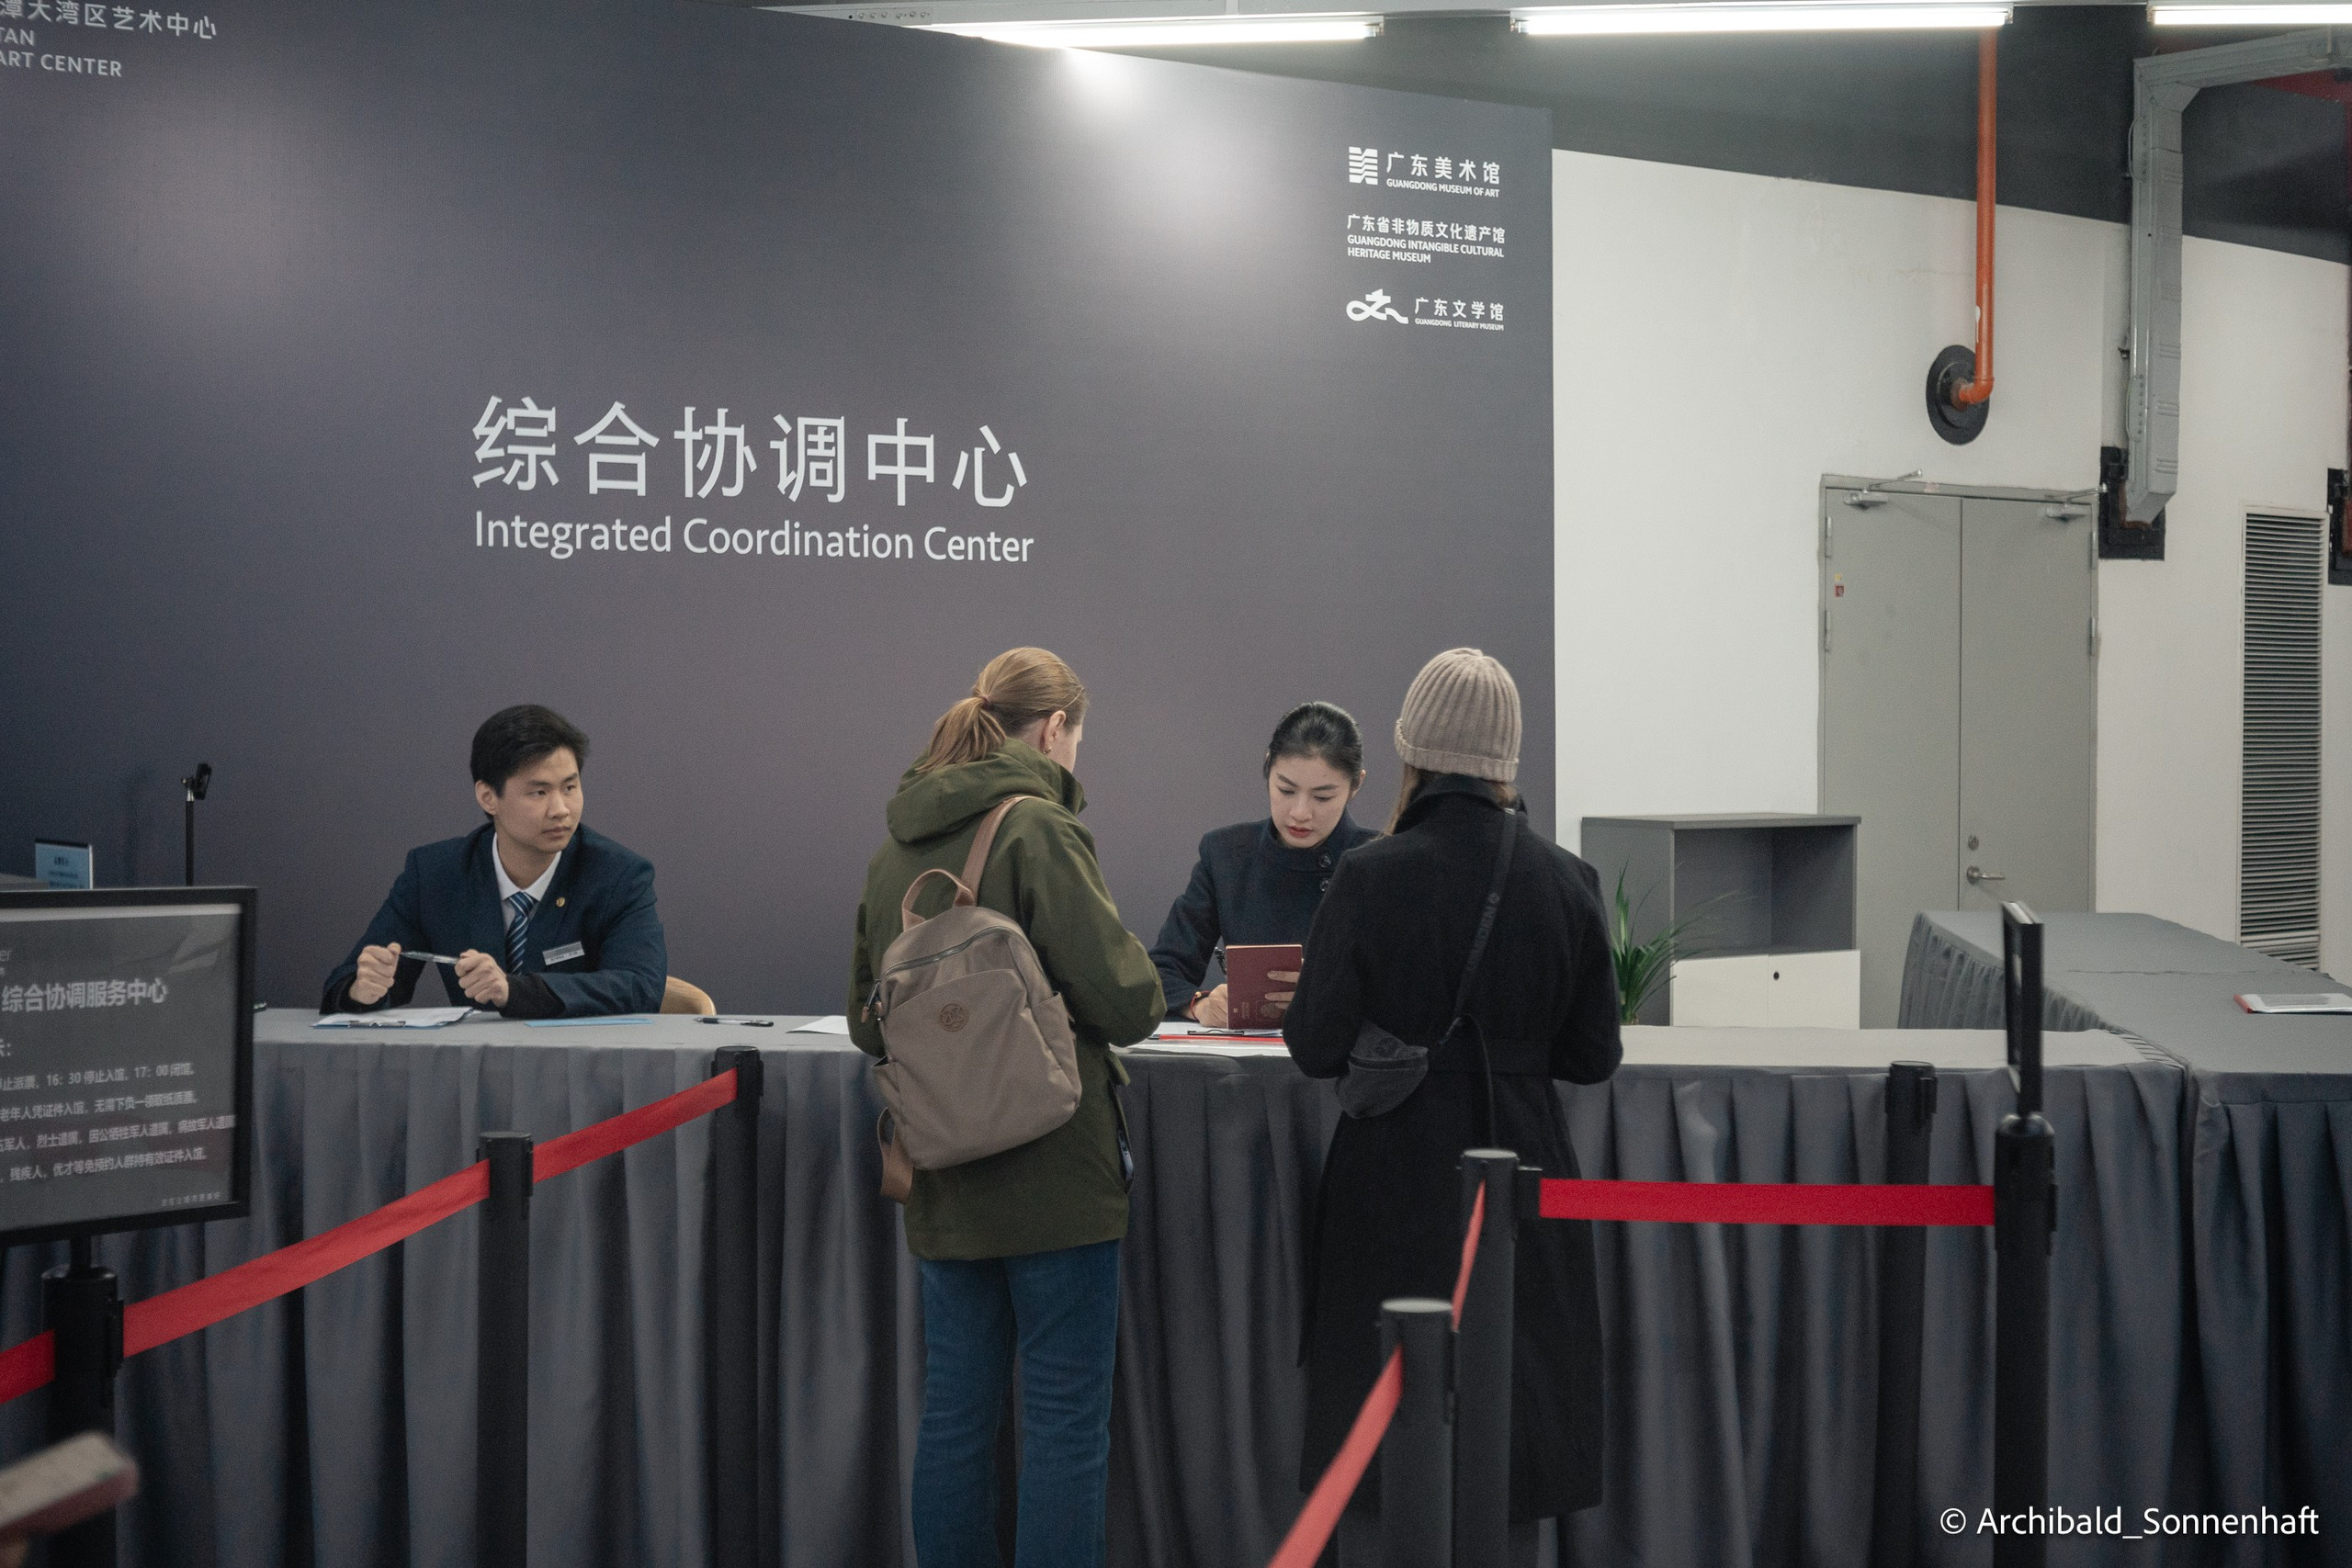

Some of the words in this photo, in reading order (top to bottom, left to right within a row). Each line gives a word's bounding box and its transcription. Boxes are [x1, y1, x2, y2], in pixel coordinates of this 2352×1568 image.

[40, 53, 122, 77] CENTER
[1385, 152, 1500, 185] 广东美术馆
[1385, 178, 1438, 192] GUANGDONG
[1438, 185, 1473, 195] MUSEUM
[1485, 188, 1500, 197] ART
[1347, 213, 1506, 244] 广东省非物质文化遗产馆
[1347, 234, 1407, 249] GUANGDONG
[1408, 240, 1459, 254] INTANGIBLE
[1460, 243, 1505, 258] CULTURAL
[1347, 247, 1391, 260] HERITAGE
[1392, 251, 1431, 264] MUSEUM
[1414, 297, 1504, 321] 广东文学馆
[1414, 317, 1453, 327] GUANGDONG
[1453, 321, 1479, 329] LITERARY
[1479, 322, 1504, 331] MUSEUM
[471, 395, 1028, 507] 综合协调中心
[475, 511, 672, 559] Integrated
[684, 517, 914, 558] Coordination
[923, 526, 1034, 562] Center
[1, 977, 168, 1012] 综合协调服务中心
